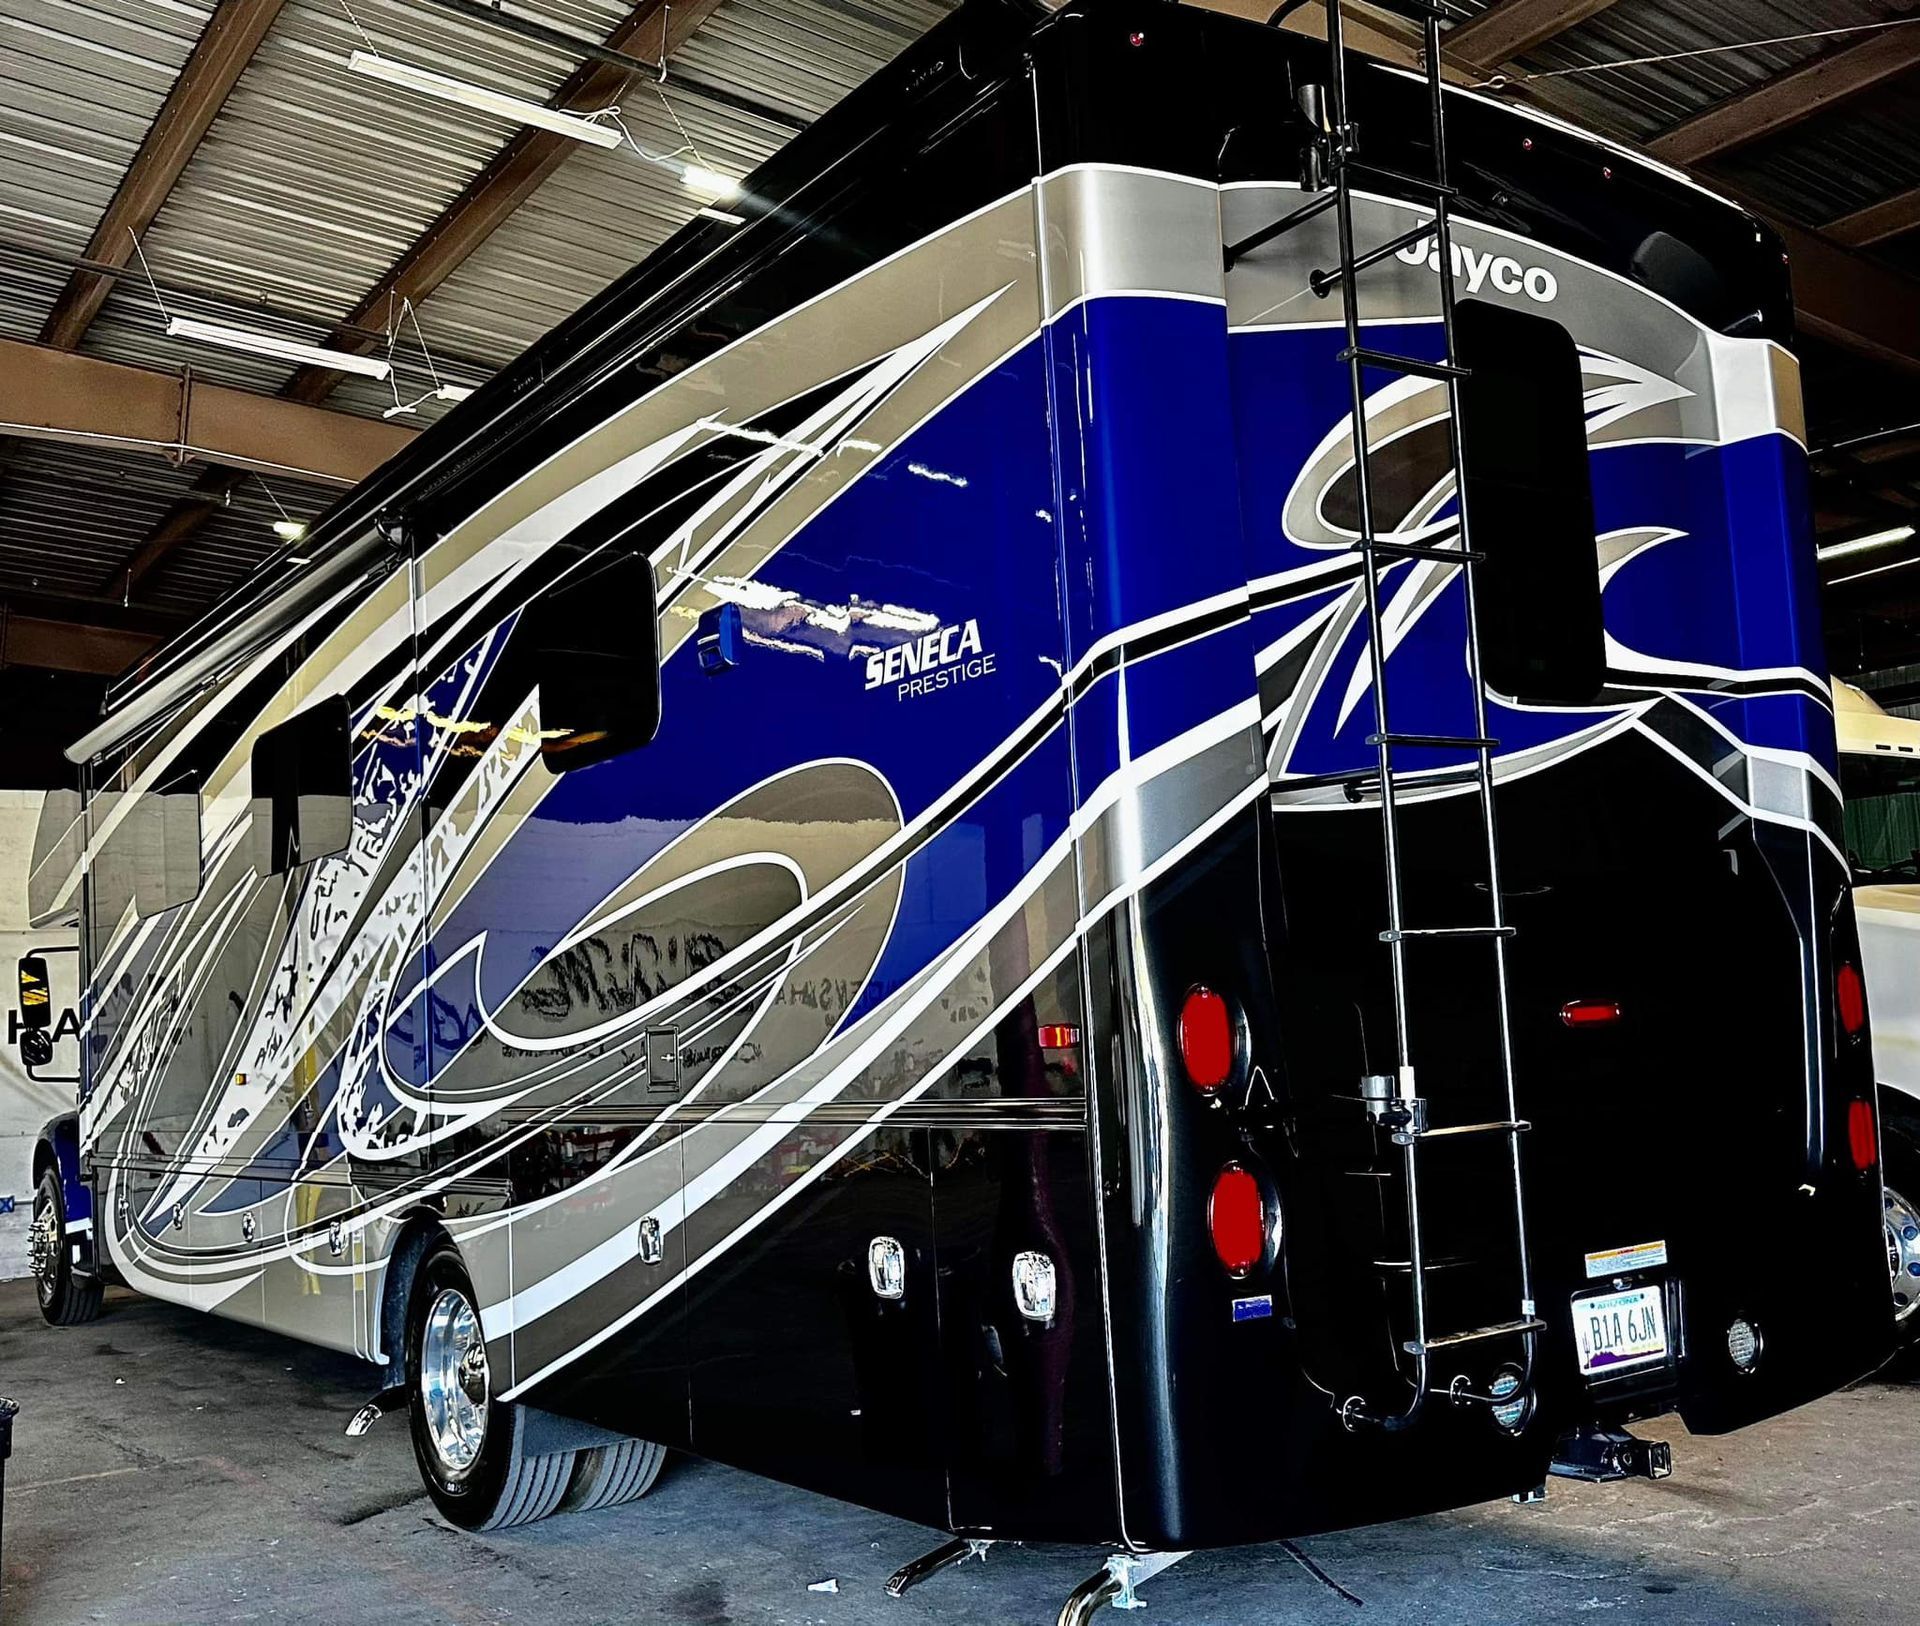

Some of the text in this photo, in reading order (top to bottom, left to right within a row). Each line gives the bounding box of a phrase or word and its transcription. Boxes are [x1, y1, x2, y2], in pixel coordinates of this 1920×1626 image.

[1394, 218, 1559, 303] Jayco
[864, 618, 983, 691] SENECA
[898, 653, 996, 702] PRESTIGE
[1628, 1305, 1657, 1343] 6JN
